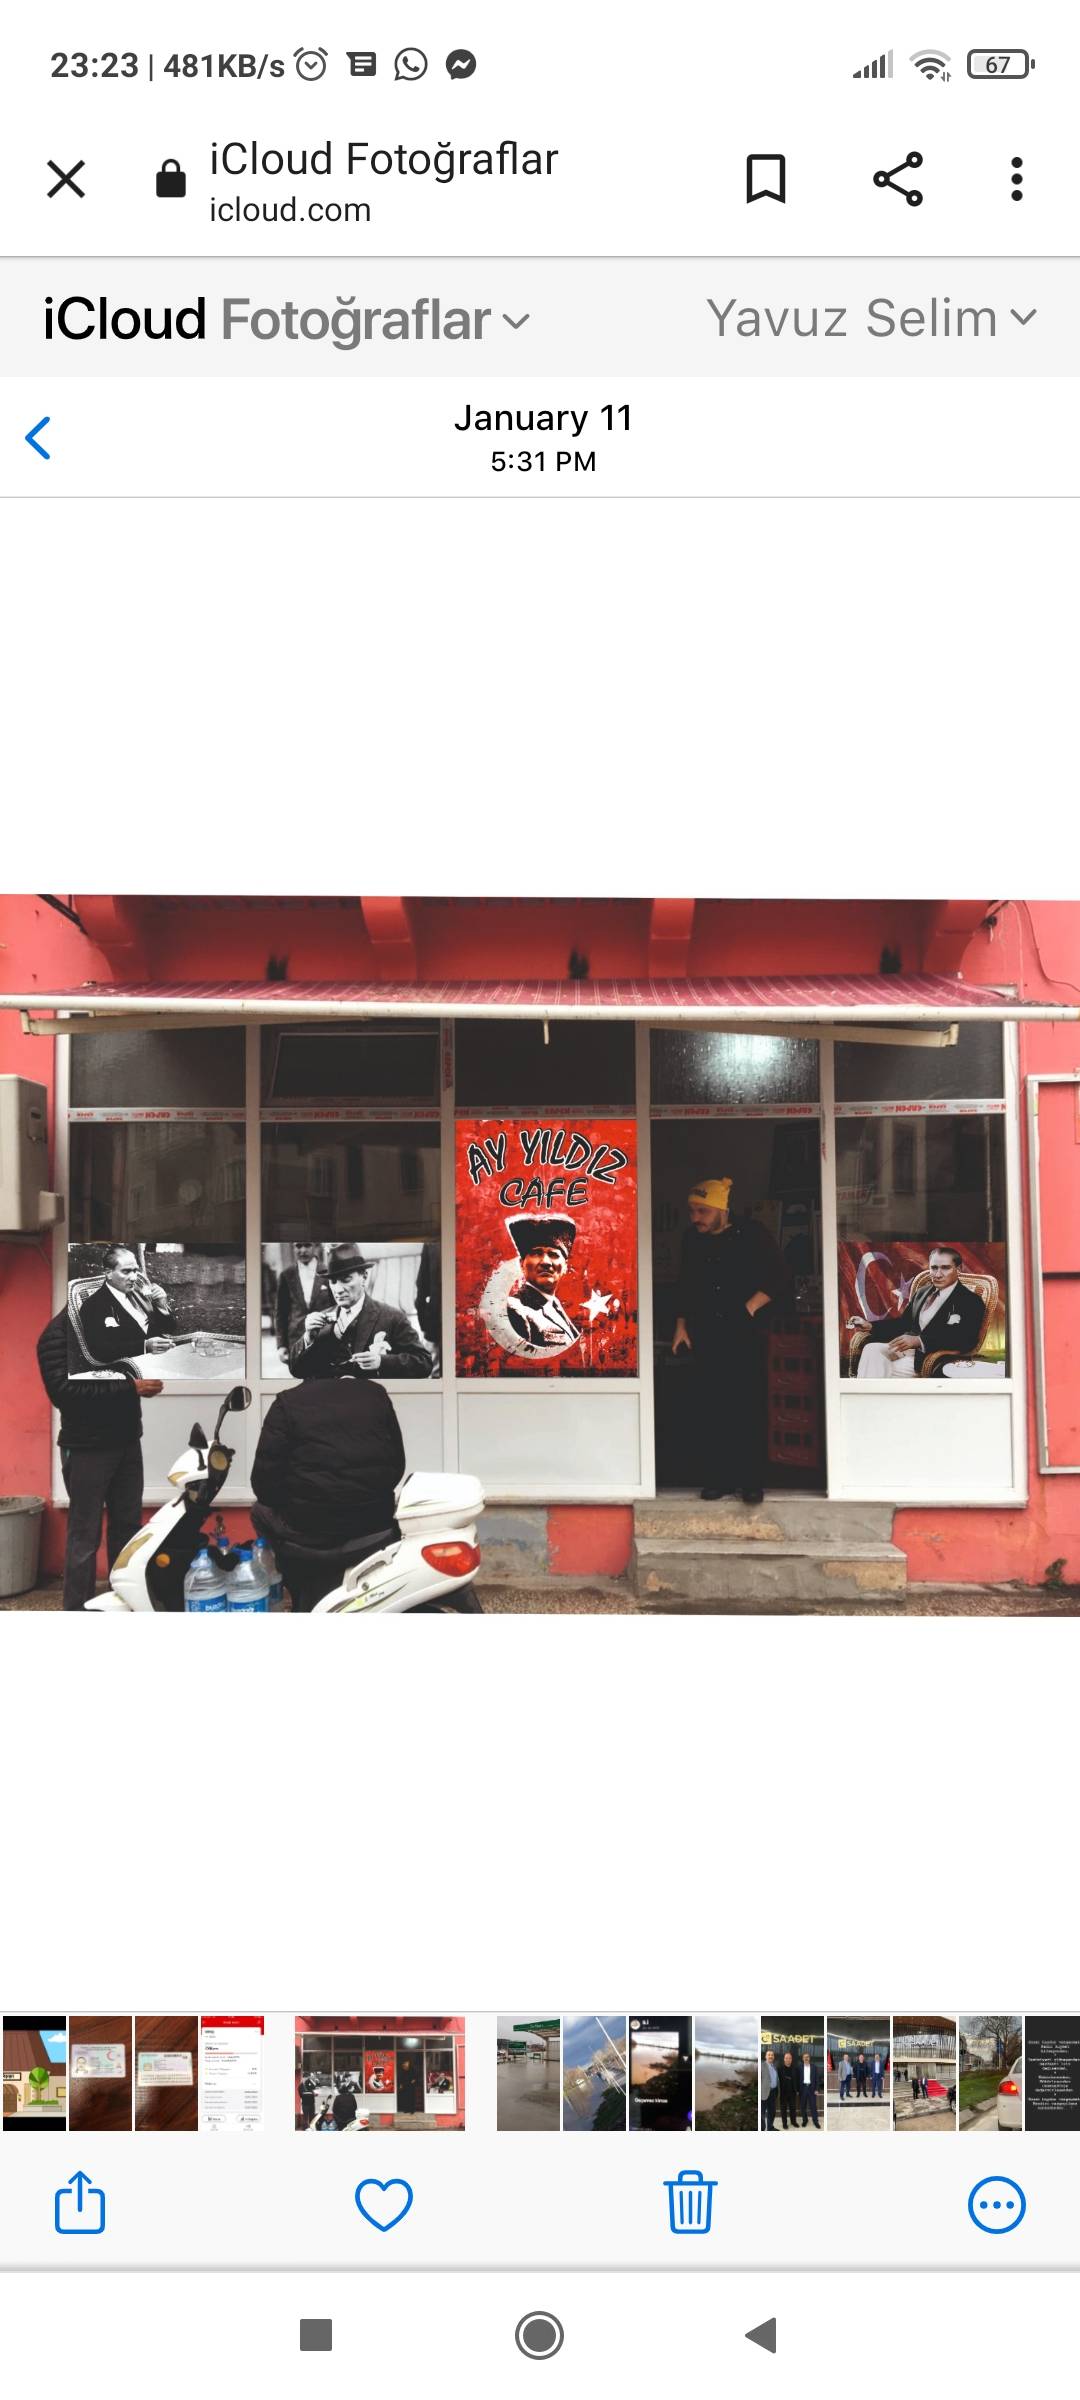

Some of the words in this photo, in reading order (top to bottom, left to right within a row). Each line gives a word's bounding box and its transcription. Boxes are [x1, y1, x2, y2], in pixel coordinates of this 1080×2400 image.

[51, 53, 138, 79] 23:23
[164, 53, 285, 80] 481KB/s
[986, 56, 1011, 74] 67
[211, 141, 332, 176] iCloud
[347, 140, 560, 184] Fotoğraflar
[210, 196, 371, 223] icloud.com
[44, 296, 206, 341] iCloud
[223, 296, 492, 351] Fotoğraflar
[707, 298, 847, 337] Yavuz
[866, 296, 996, 338] Selim
[455, 404, 589, 438] January
[600, 403, 630, 431] 11
[492, 451, 545, 472] 5:31
[556, 451, 596, 472] PM
[467, 1131, 507, 1187] AY
[519, 1127, 629, 1185] YILDIZ
[498, 1176, 589, 1210] CAFE
